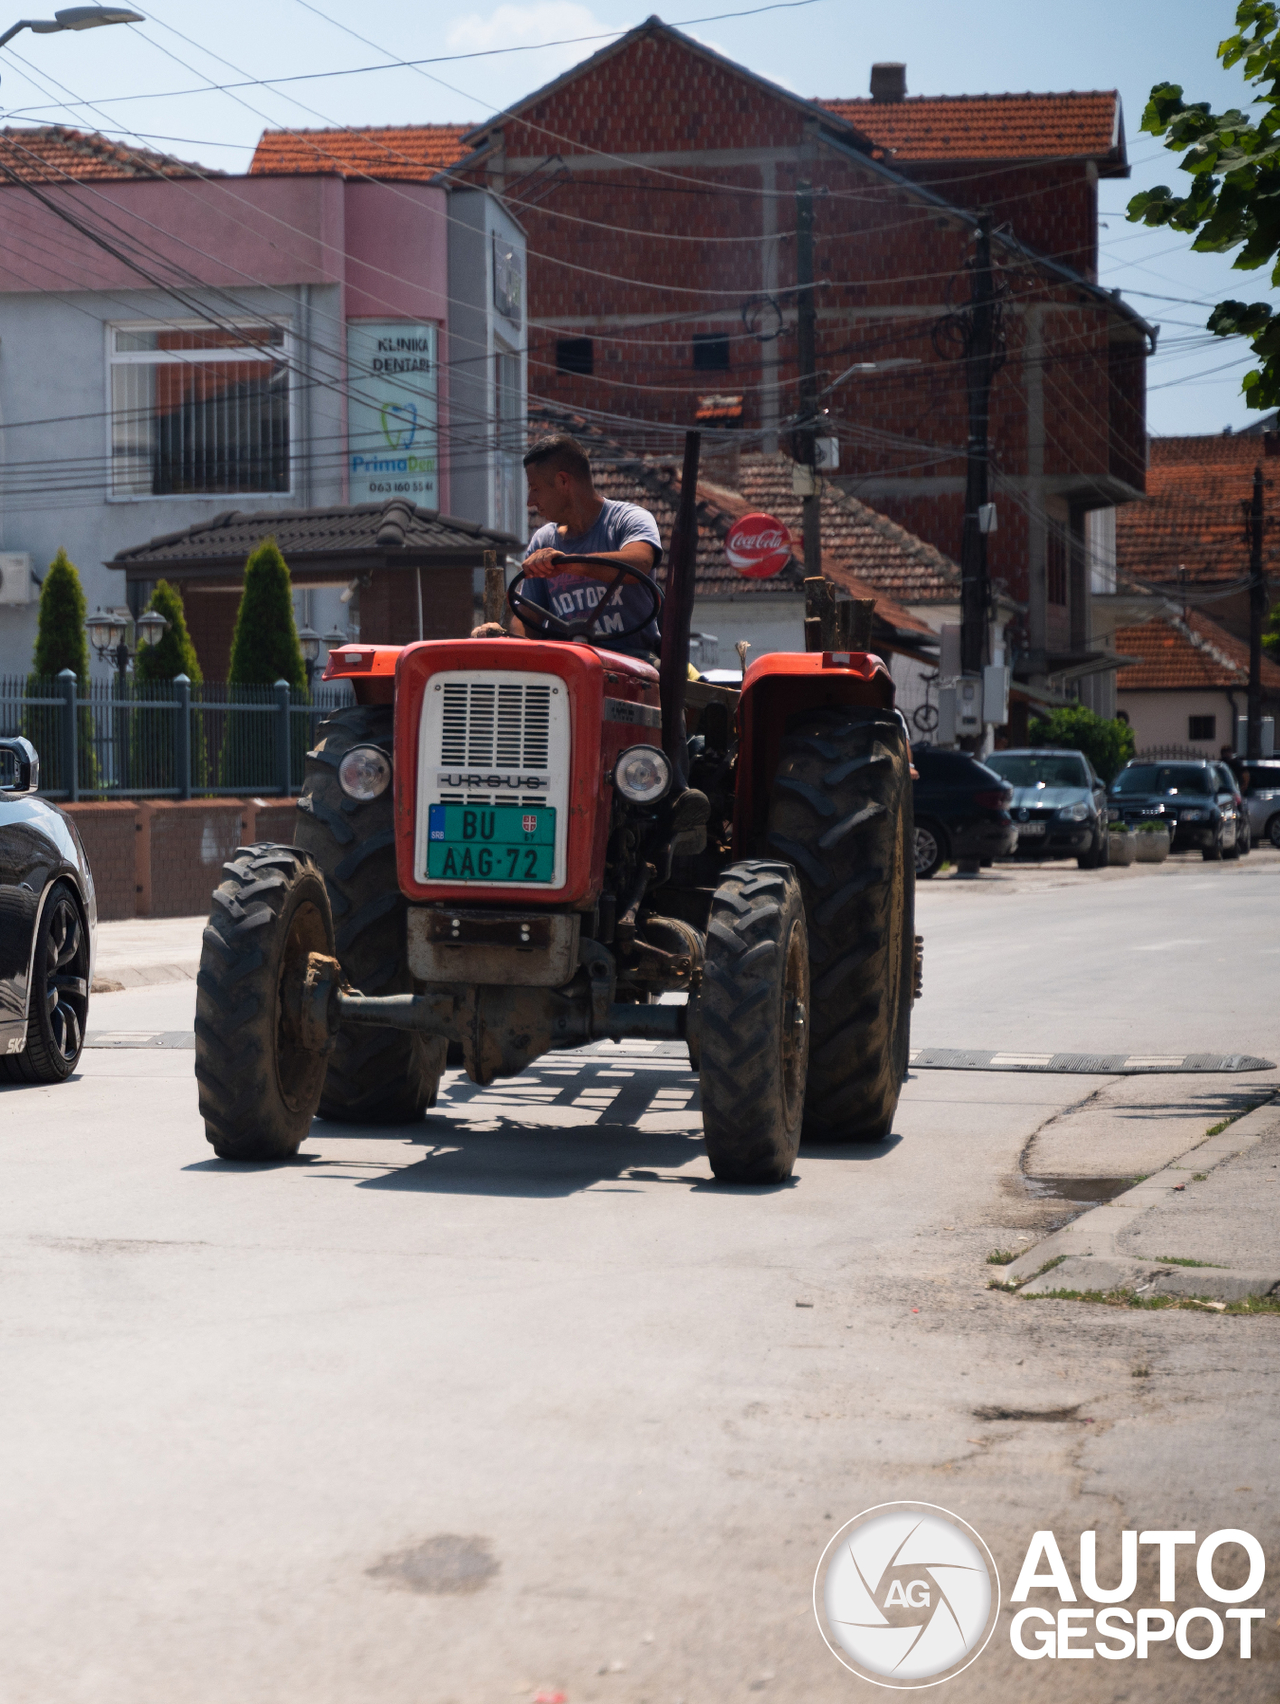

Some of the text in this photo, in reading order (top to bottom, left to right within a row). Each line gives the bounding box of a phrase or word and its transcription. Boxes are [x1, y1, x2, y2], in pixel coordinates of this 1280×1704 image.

[378, 338, 429, 352] KLINIKA
[369, 482, 391, 493] 063
[441, 774, 547, 789] URSUS
[463, 811, 495, 840] BU
[431, 831, 445, 839] SRB
